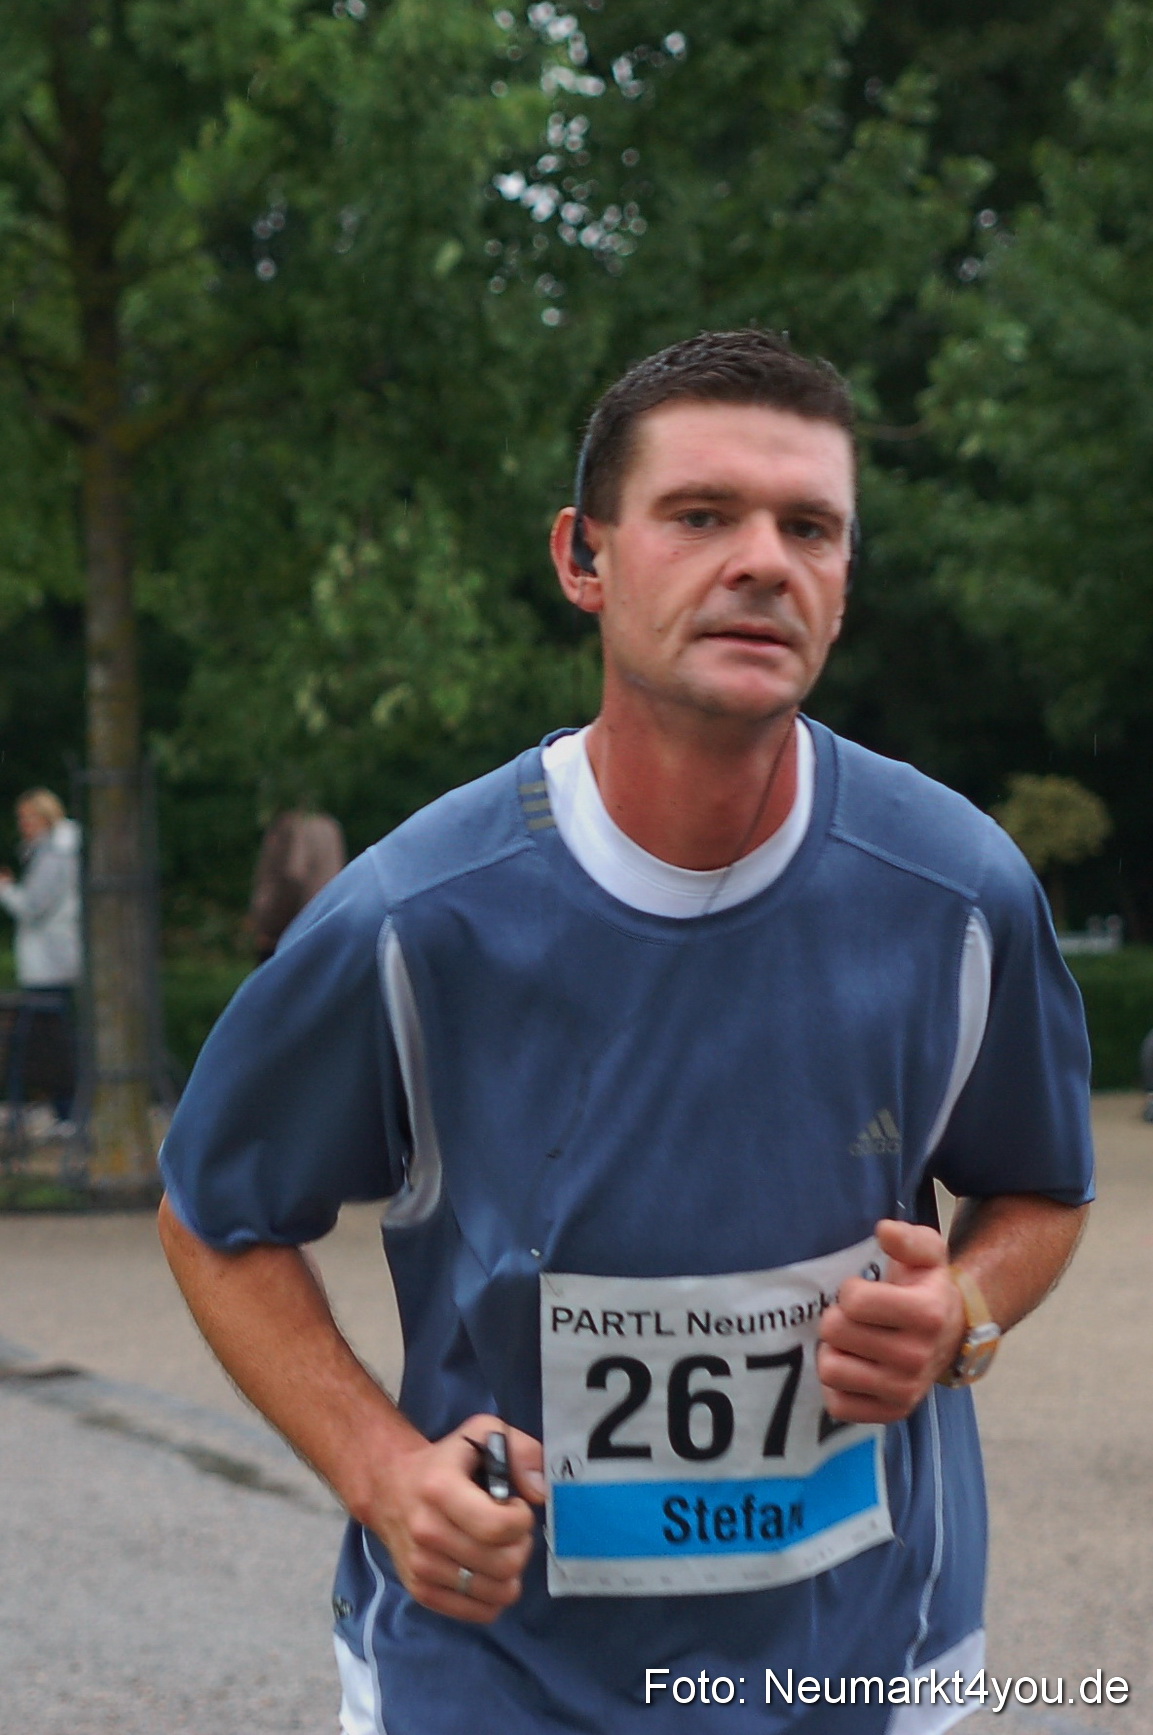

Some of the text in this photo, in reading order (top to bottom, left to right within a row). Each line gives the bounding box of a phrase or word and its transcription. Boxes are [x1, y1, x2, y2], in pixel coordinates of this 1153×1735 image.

[551, 1288, 840, 1337] PARTL Neumark
[585, 1344, 849, 1462] 267
